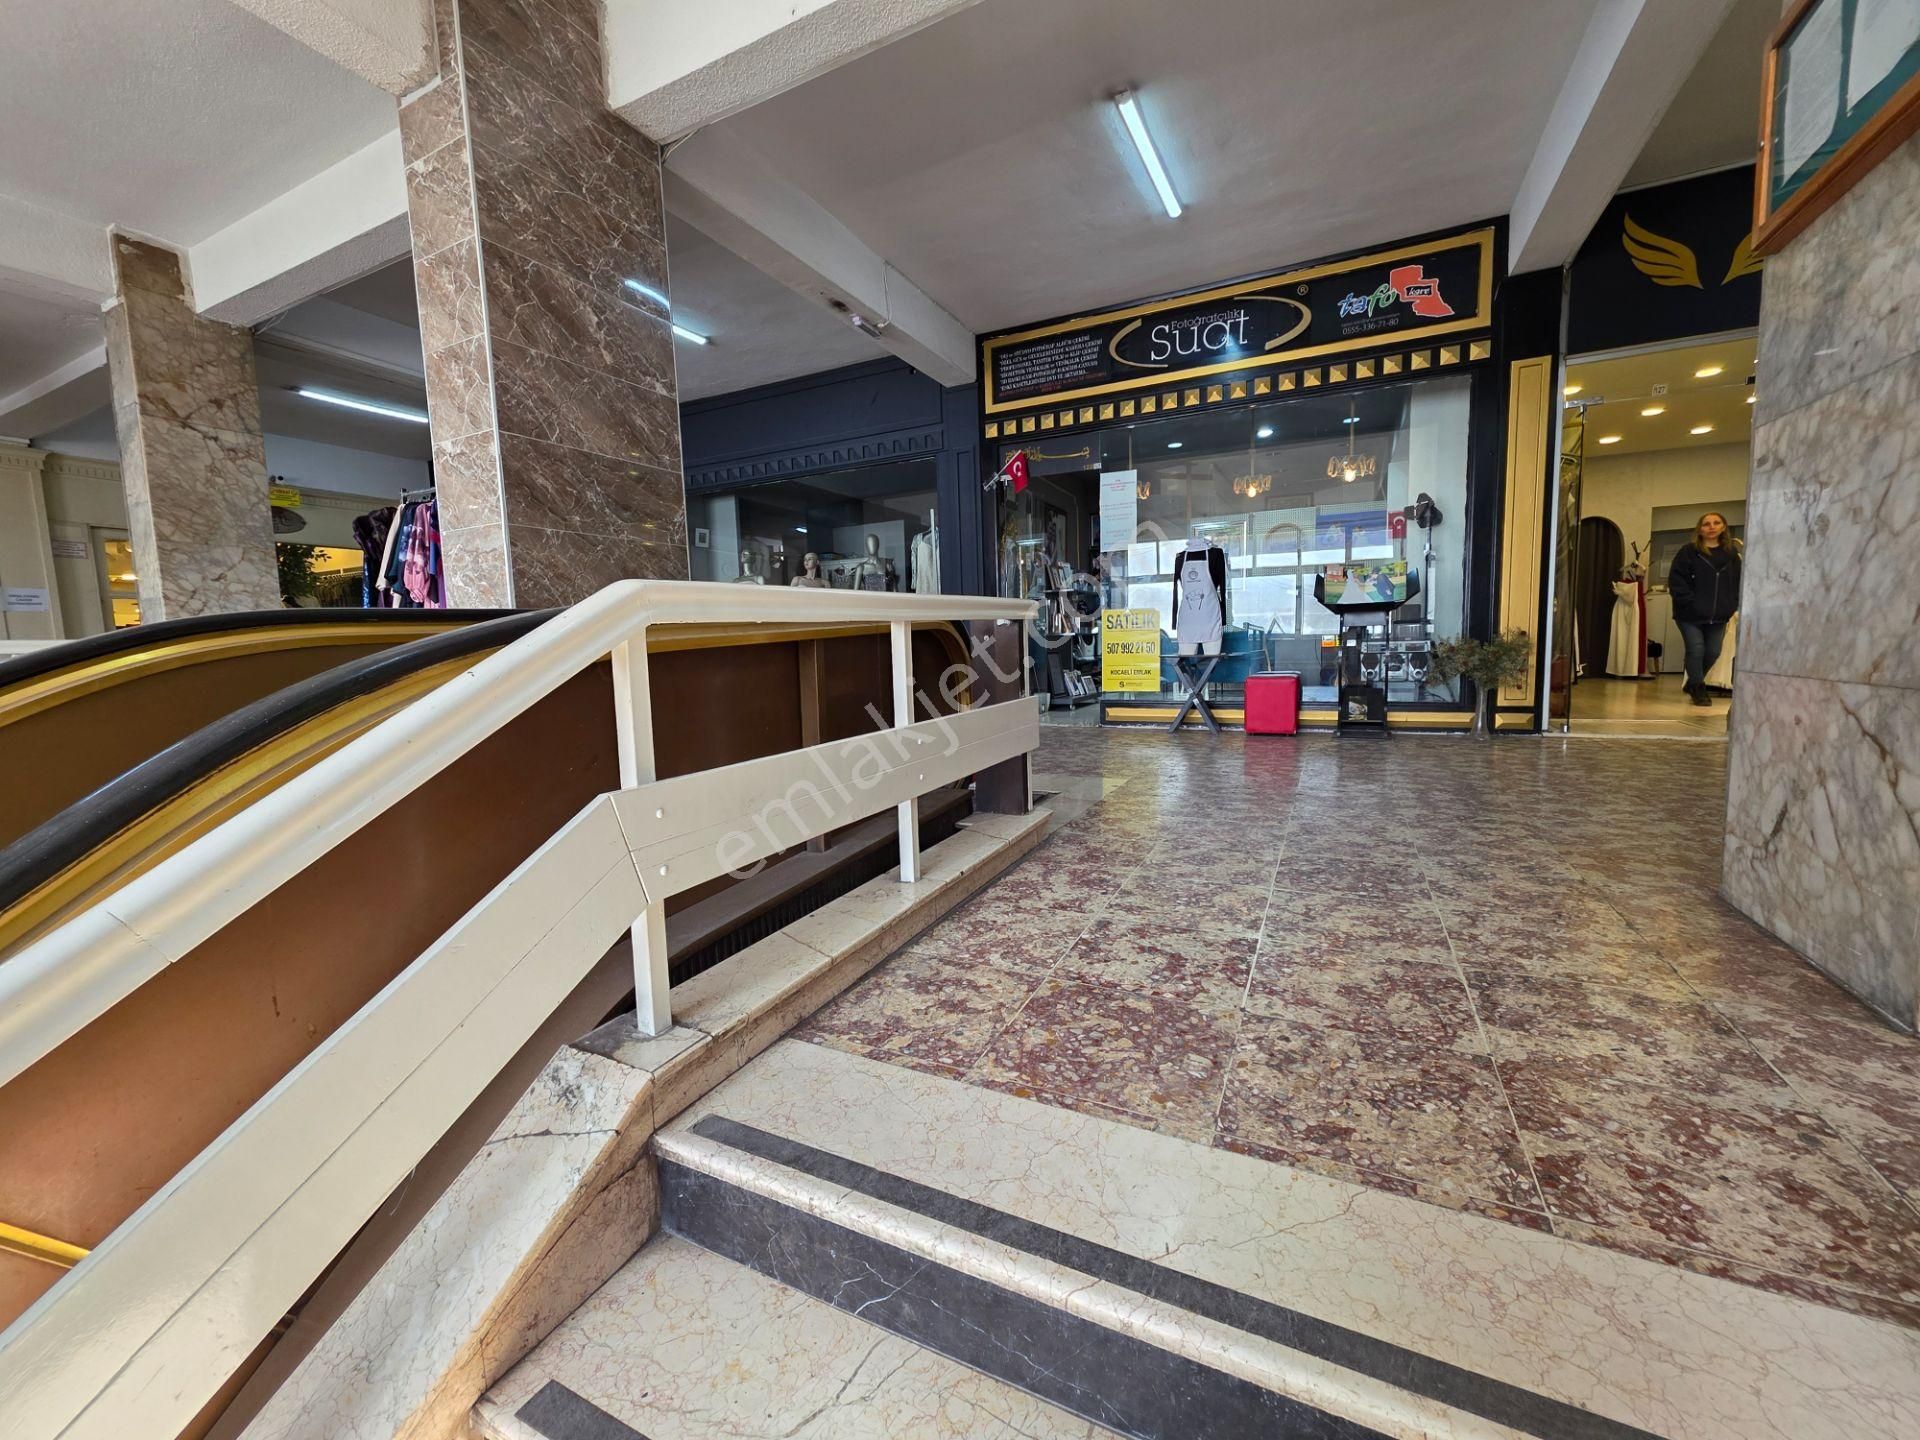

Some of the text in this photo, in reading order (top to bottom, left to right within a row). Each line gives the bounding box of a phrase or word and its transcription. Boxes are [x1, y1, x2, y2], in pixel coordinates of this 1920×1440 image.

[1171, 308, 1241, 330] Fotoğrafçılık
[1151, 309, 1249, 361] Suat
[1106, 613, 1154, 630] SATILIK
[1106, 641, 1156, 655] 507 992 21 50
